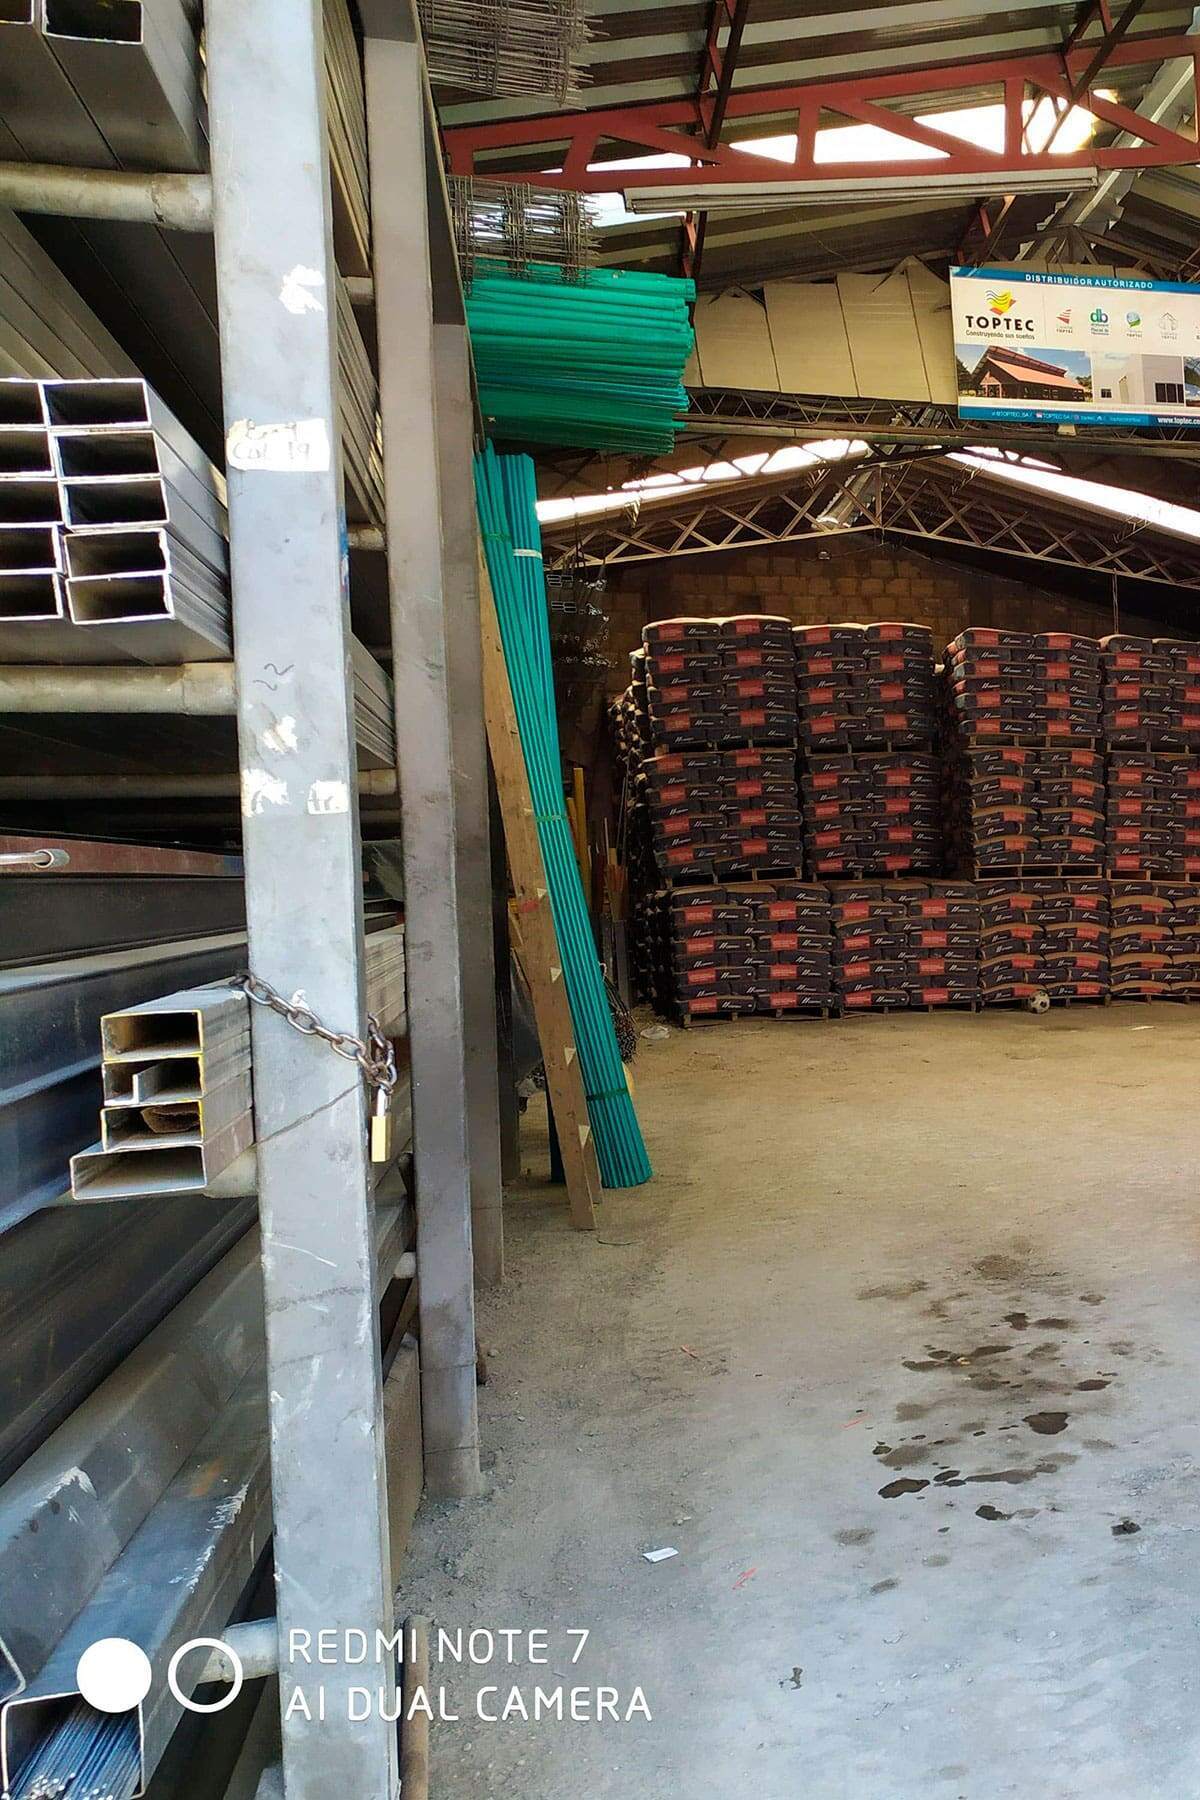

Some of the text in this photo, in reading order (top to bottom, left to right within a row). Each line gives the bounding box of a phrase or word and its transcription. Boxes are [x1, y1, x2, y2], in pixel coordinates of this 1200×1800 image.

[1025, 273, 1153, 289] DISTRIBUIDOR AUTORIZADO
[965, 315, 1034, 332] TOPTEC
